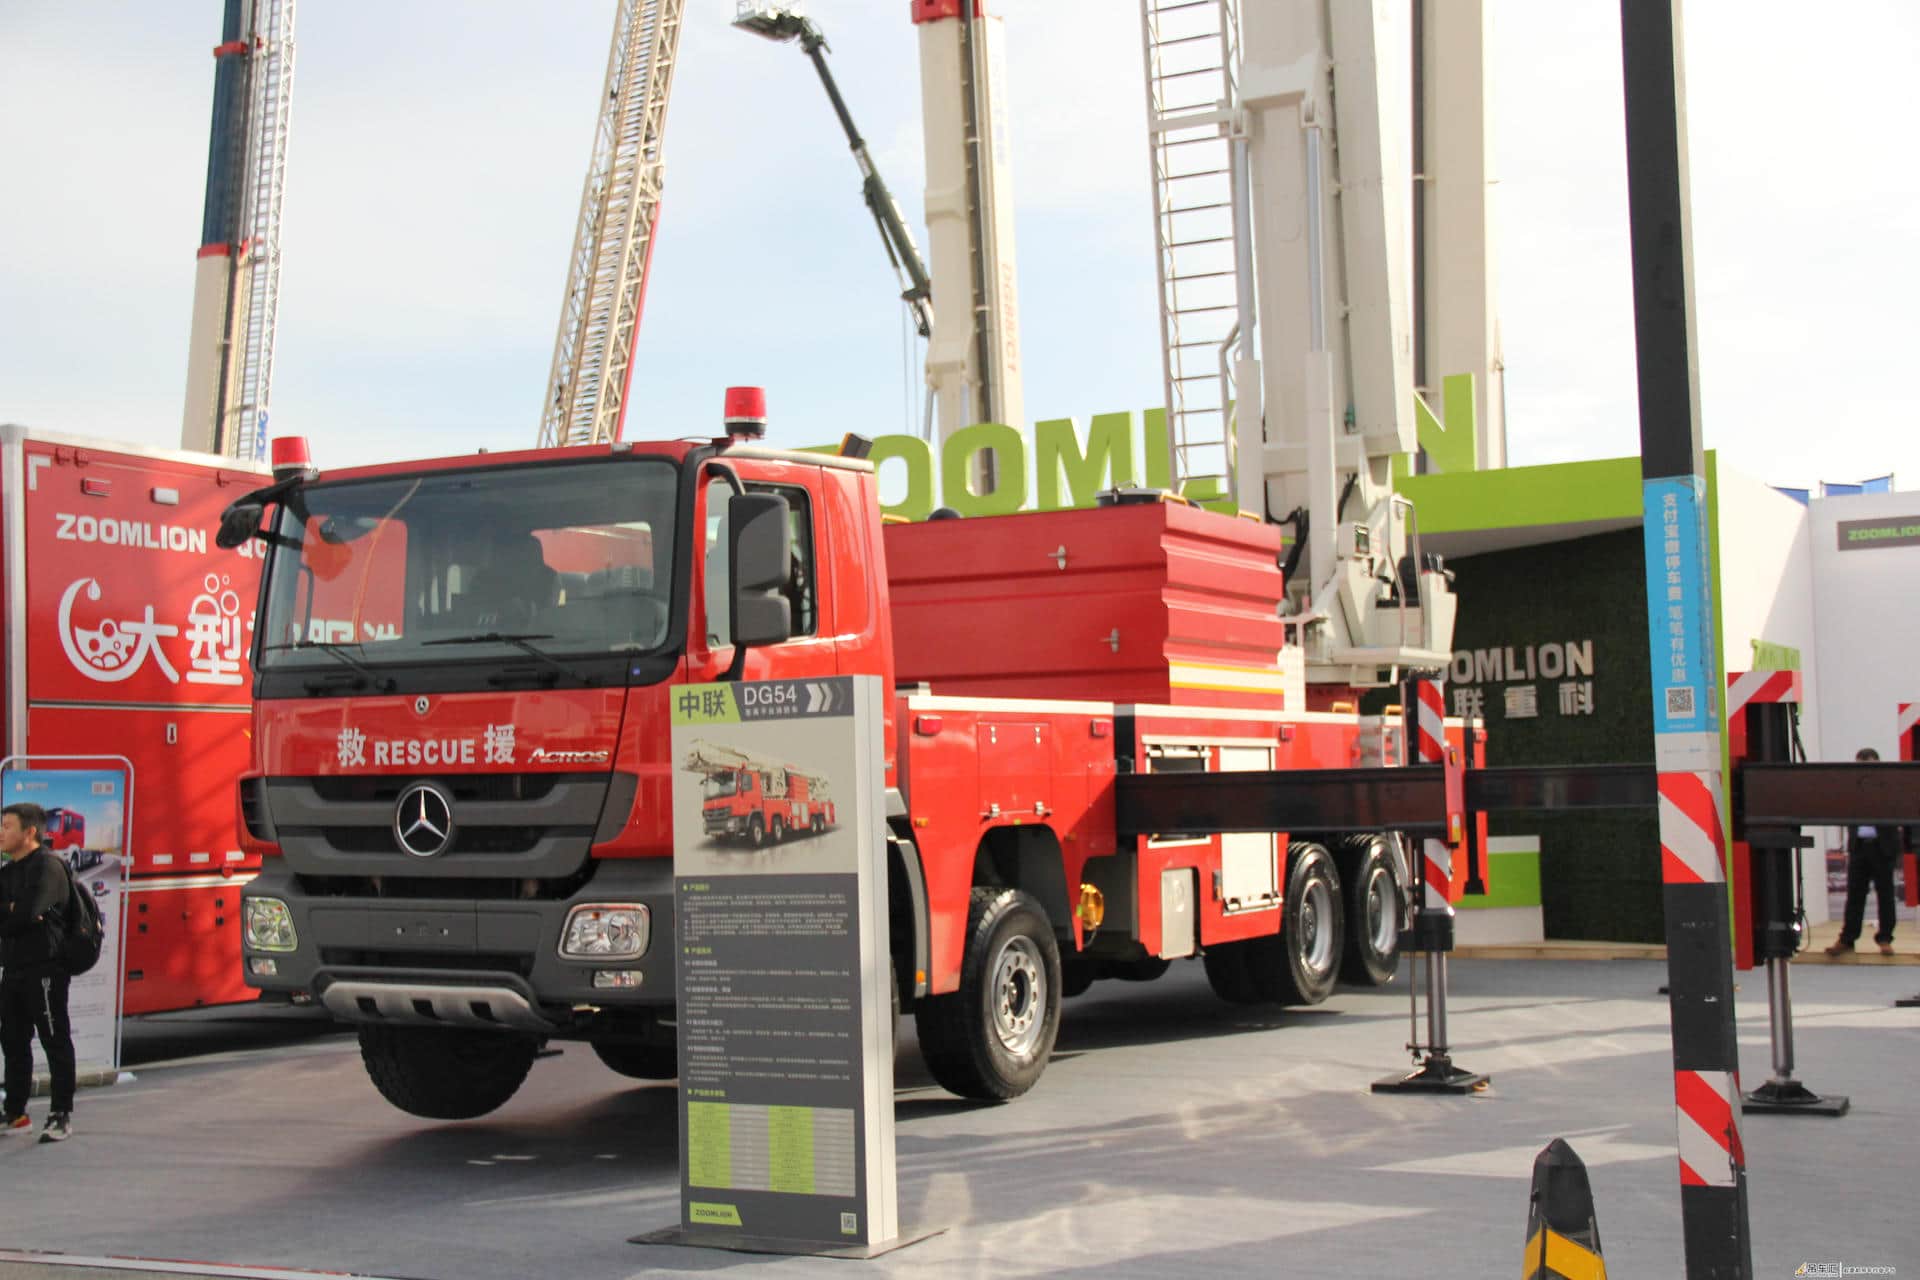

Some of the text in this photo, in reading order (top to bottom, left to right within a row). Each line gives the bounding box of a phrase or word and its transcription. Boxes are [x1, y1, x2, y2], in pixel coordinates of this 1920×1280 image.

[56, 513, 207, 554] ZOOMLION
[1440, 639, 1594, 684] OMLION
[678, 690, 726, 720] 中联
[743, 684, 797, 706] DG54
[1453, 682, 1594, 719] 联重科
[337, 723, 516, 768] 救 RESCUE 援
[695, 1208, 733, 1218] ZOOMLION
